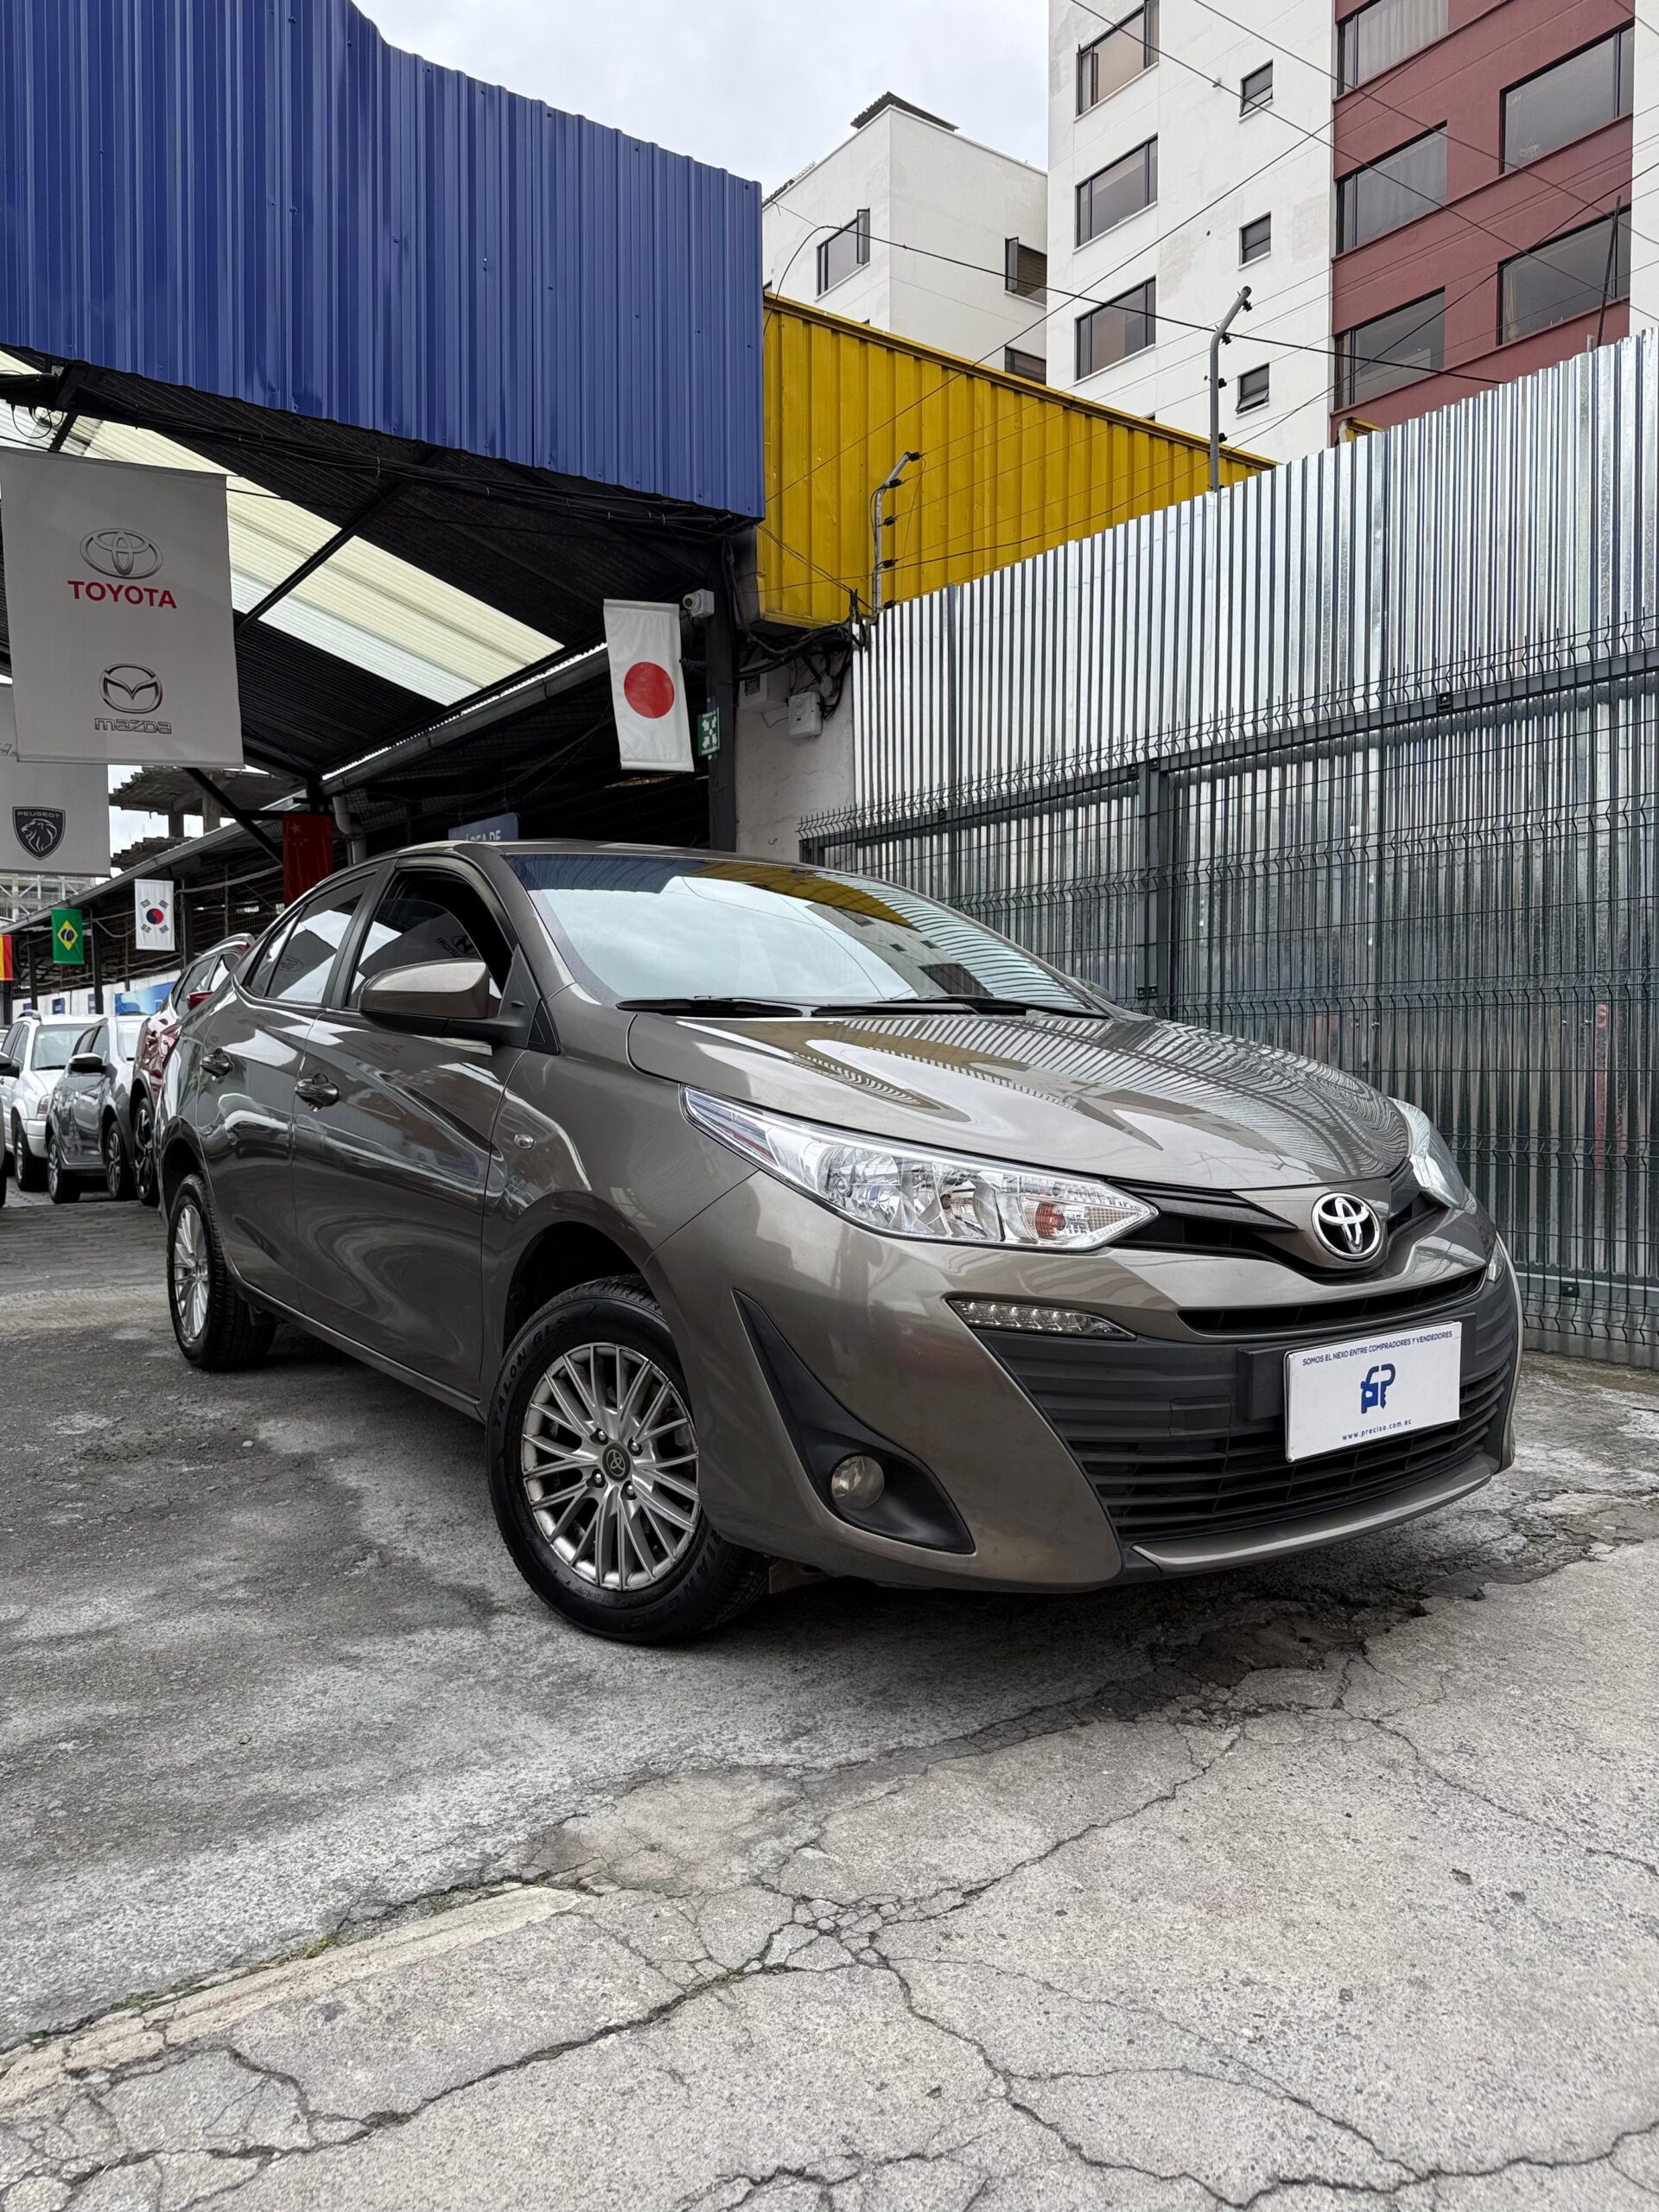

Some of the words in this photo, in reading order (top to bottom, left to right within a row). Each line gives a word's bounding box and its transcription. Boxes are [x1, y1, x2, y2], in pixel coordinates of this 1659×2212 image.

[67, 581, 177, 608] TOYOTA
[16, 810, 60, 819] PEUGEOT
[1302, 1355, 1324, 1366] SOMOS
[1332, 1351, 1348, 1360] NEXO
[1349, 1346, 1368, 1357] ENTRE
[1368, 1338, 1411, 1353] COMPRADORES
[1416, 1330, 1452, 1344] VENDEDORES
[493, 1347, 527, 1427] TALON
[1342, 1419, 1412, 1440] www.preciso.com.ec
